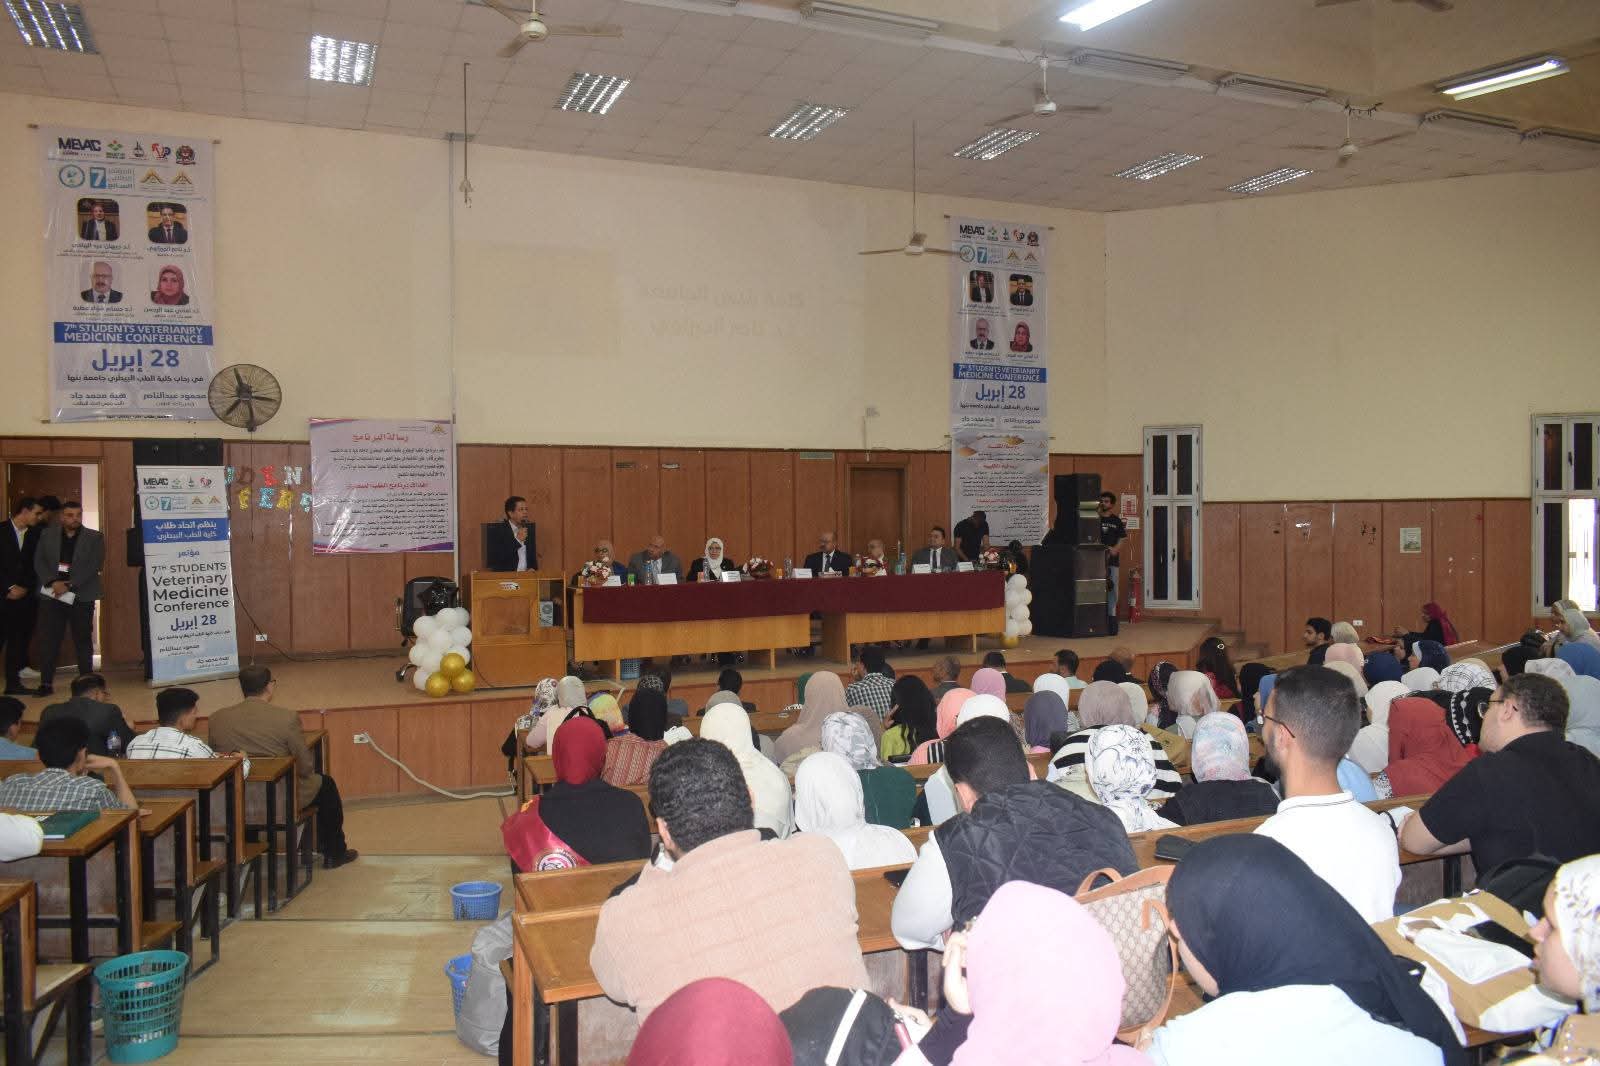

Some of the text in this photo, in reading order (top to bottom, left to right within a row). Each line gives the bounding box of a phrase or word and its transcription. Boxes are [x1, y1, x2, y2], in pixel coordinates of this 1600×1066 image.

[58, 137, 101, 151] MEVAC
[960, 225, 985, 236] MEVAC
[79, 324, 135, 333] STUDENTS
[138, 325, 203, 335] VETERIANRY
[64, 332, 203, 343] MEDICINE CONFERENCE
[92, 349, 180, 372] 28 إبريل
[968, 365, 1001, 373] STUDENTS
[958, 371, 1040, 382] MEDICINE CONFERENCE
[975, 384, 1026, 402] 28 إبريل
[143, 478, 168, 486] MEVAC
[155, 520, 217, 530] ينظم اتحاد طلاب
[178, 549, 200, 558] مؤتمر
[170, 562, 227, 573] STUDENTS
[152, 574, 227, 587] Veterinary
[153, 585, 229, 601] Medicine
[154, 600, 230, 613] Conference
[170, 614, 217, 631] 28 إبريل
